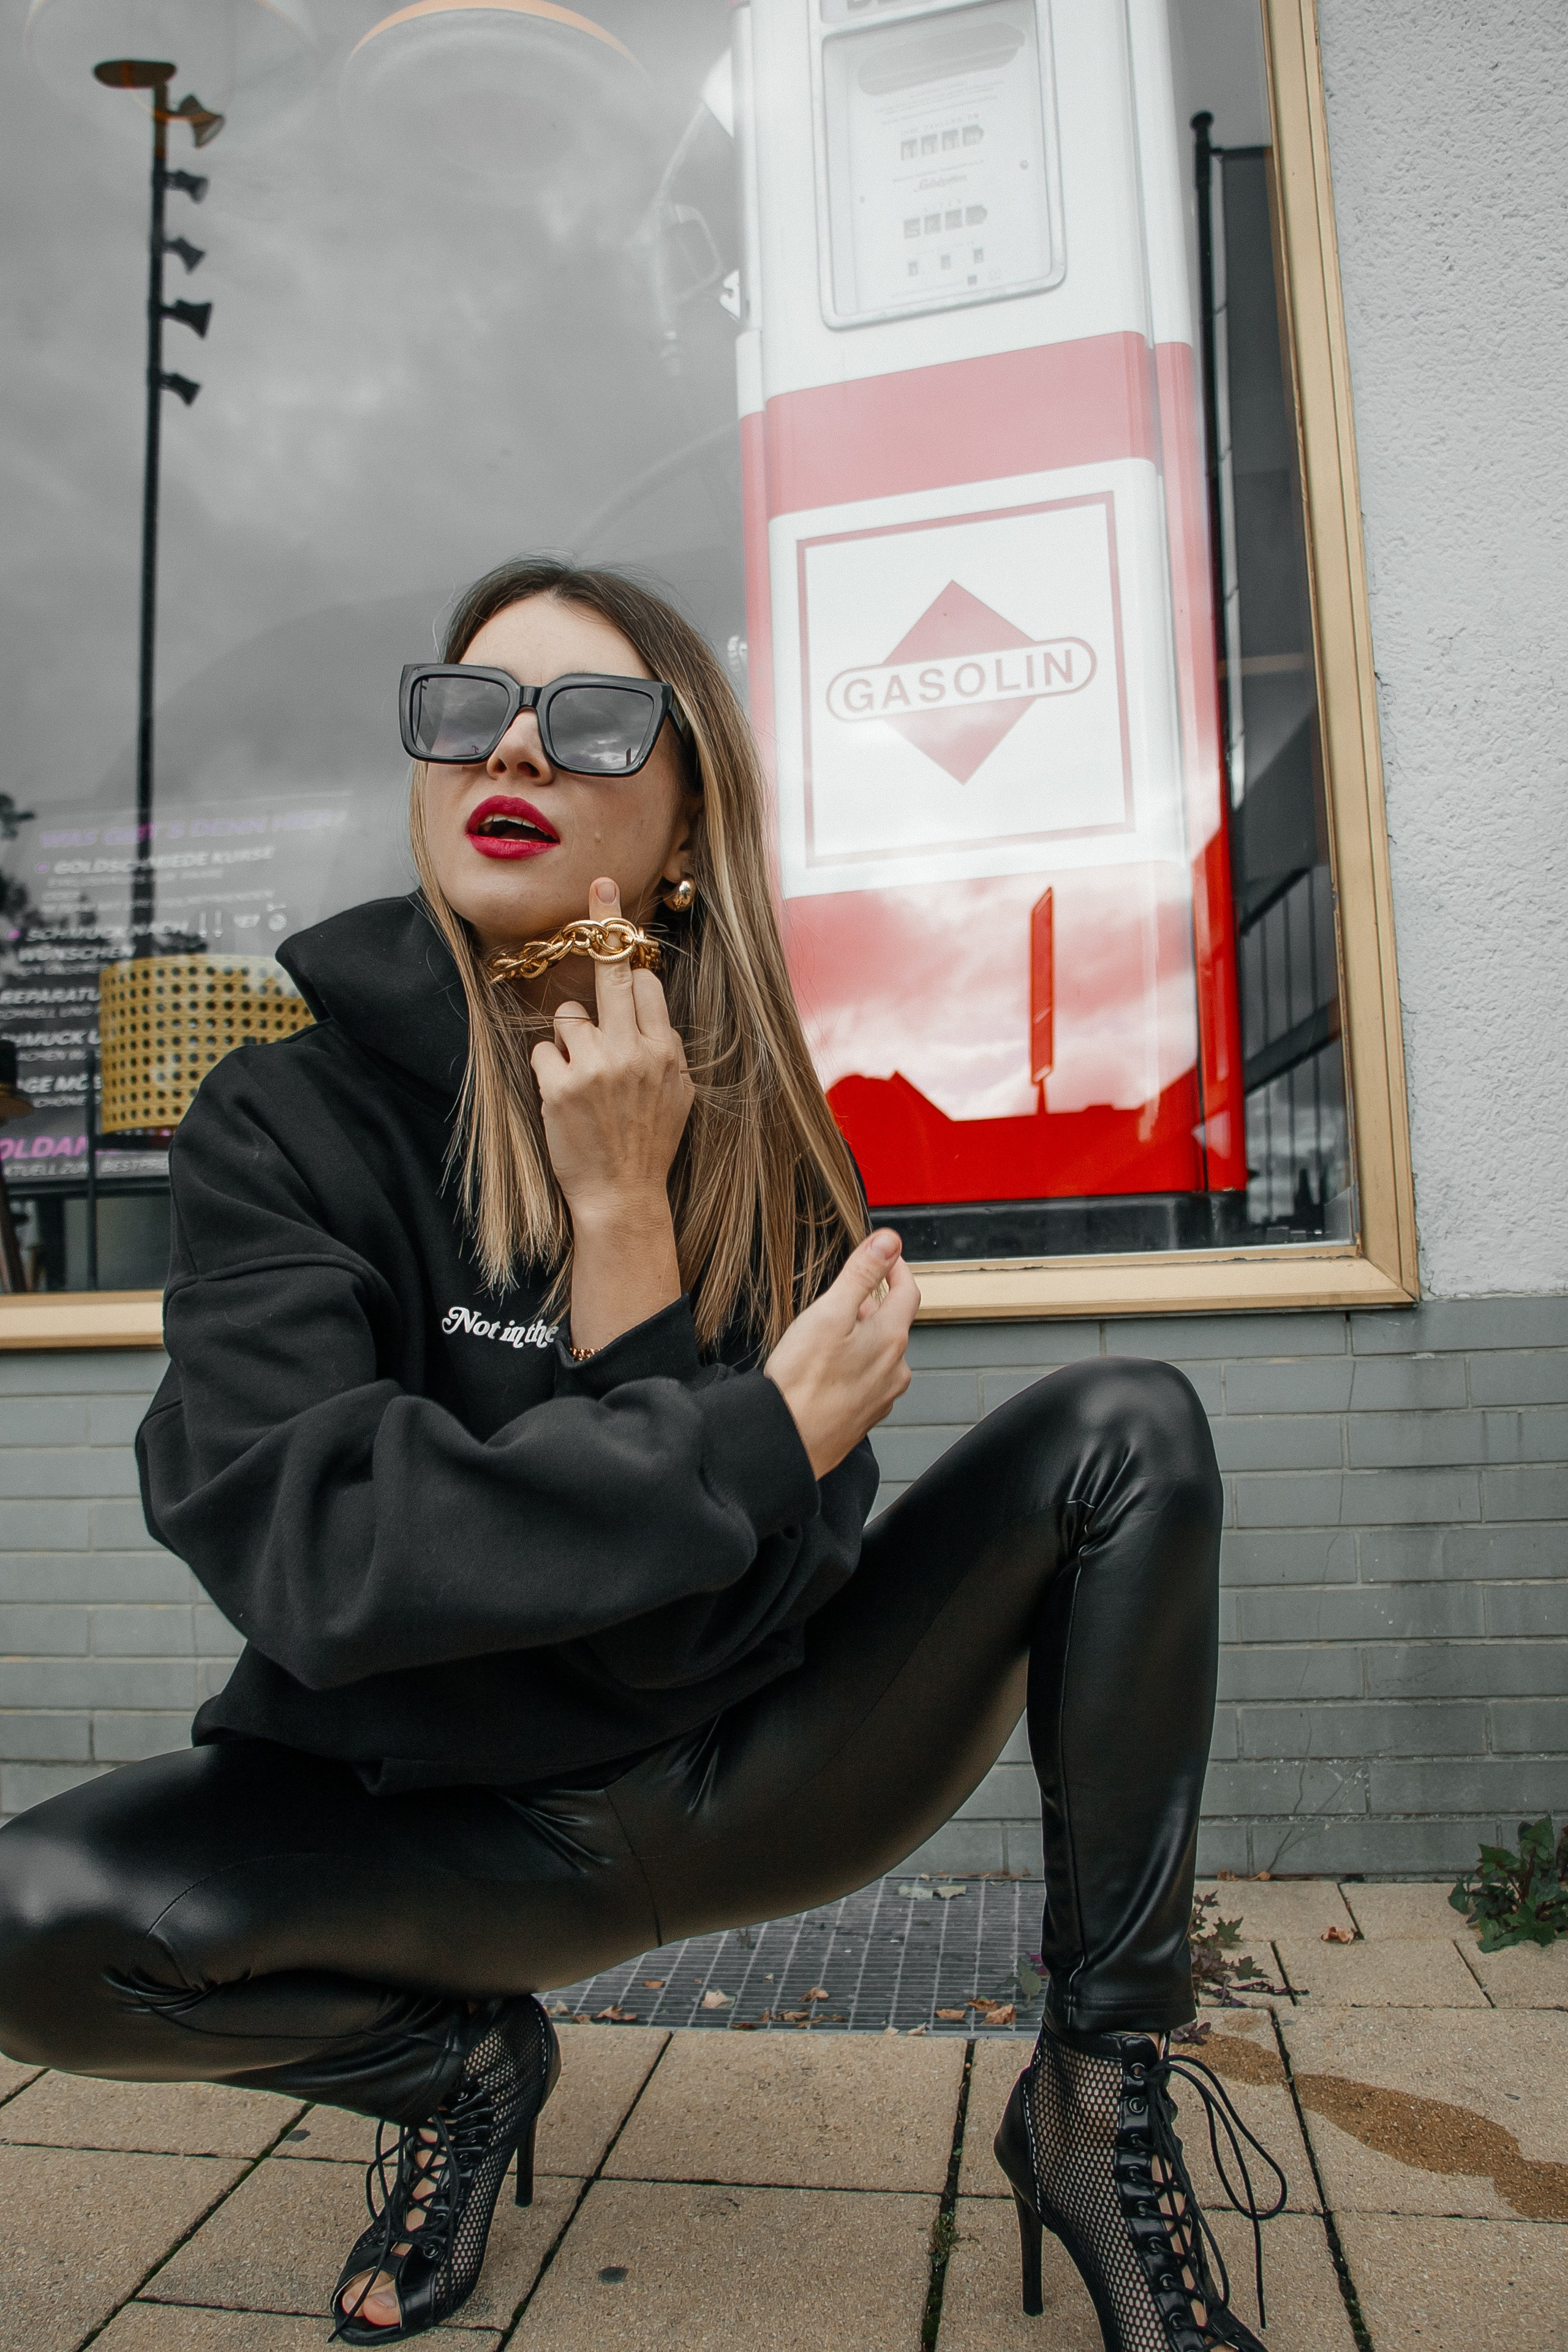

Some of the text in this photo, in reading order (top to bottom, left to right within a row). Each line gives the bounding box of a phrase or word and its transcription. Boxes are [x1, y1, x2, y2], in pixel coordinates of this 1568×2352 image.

[843, 649, 1074, 713] GASOLIN
[442, 1306, 559, 1348] Not in the
